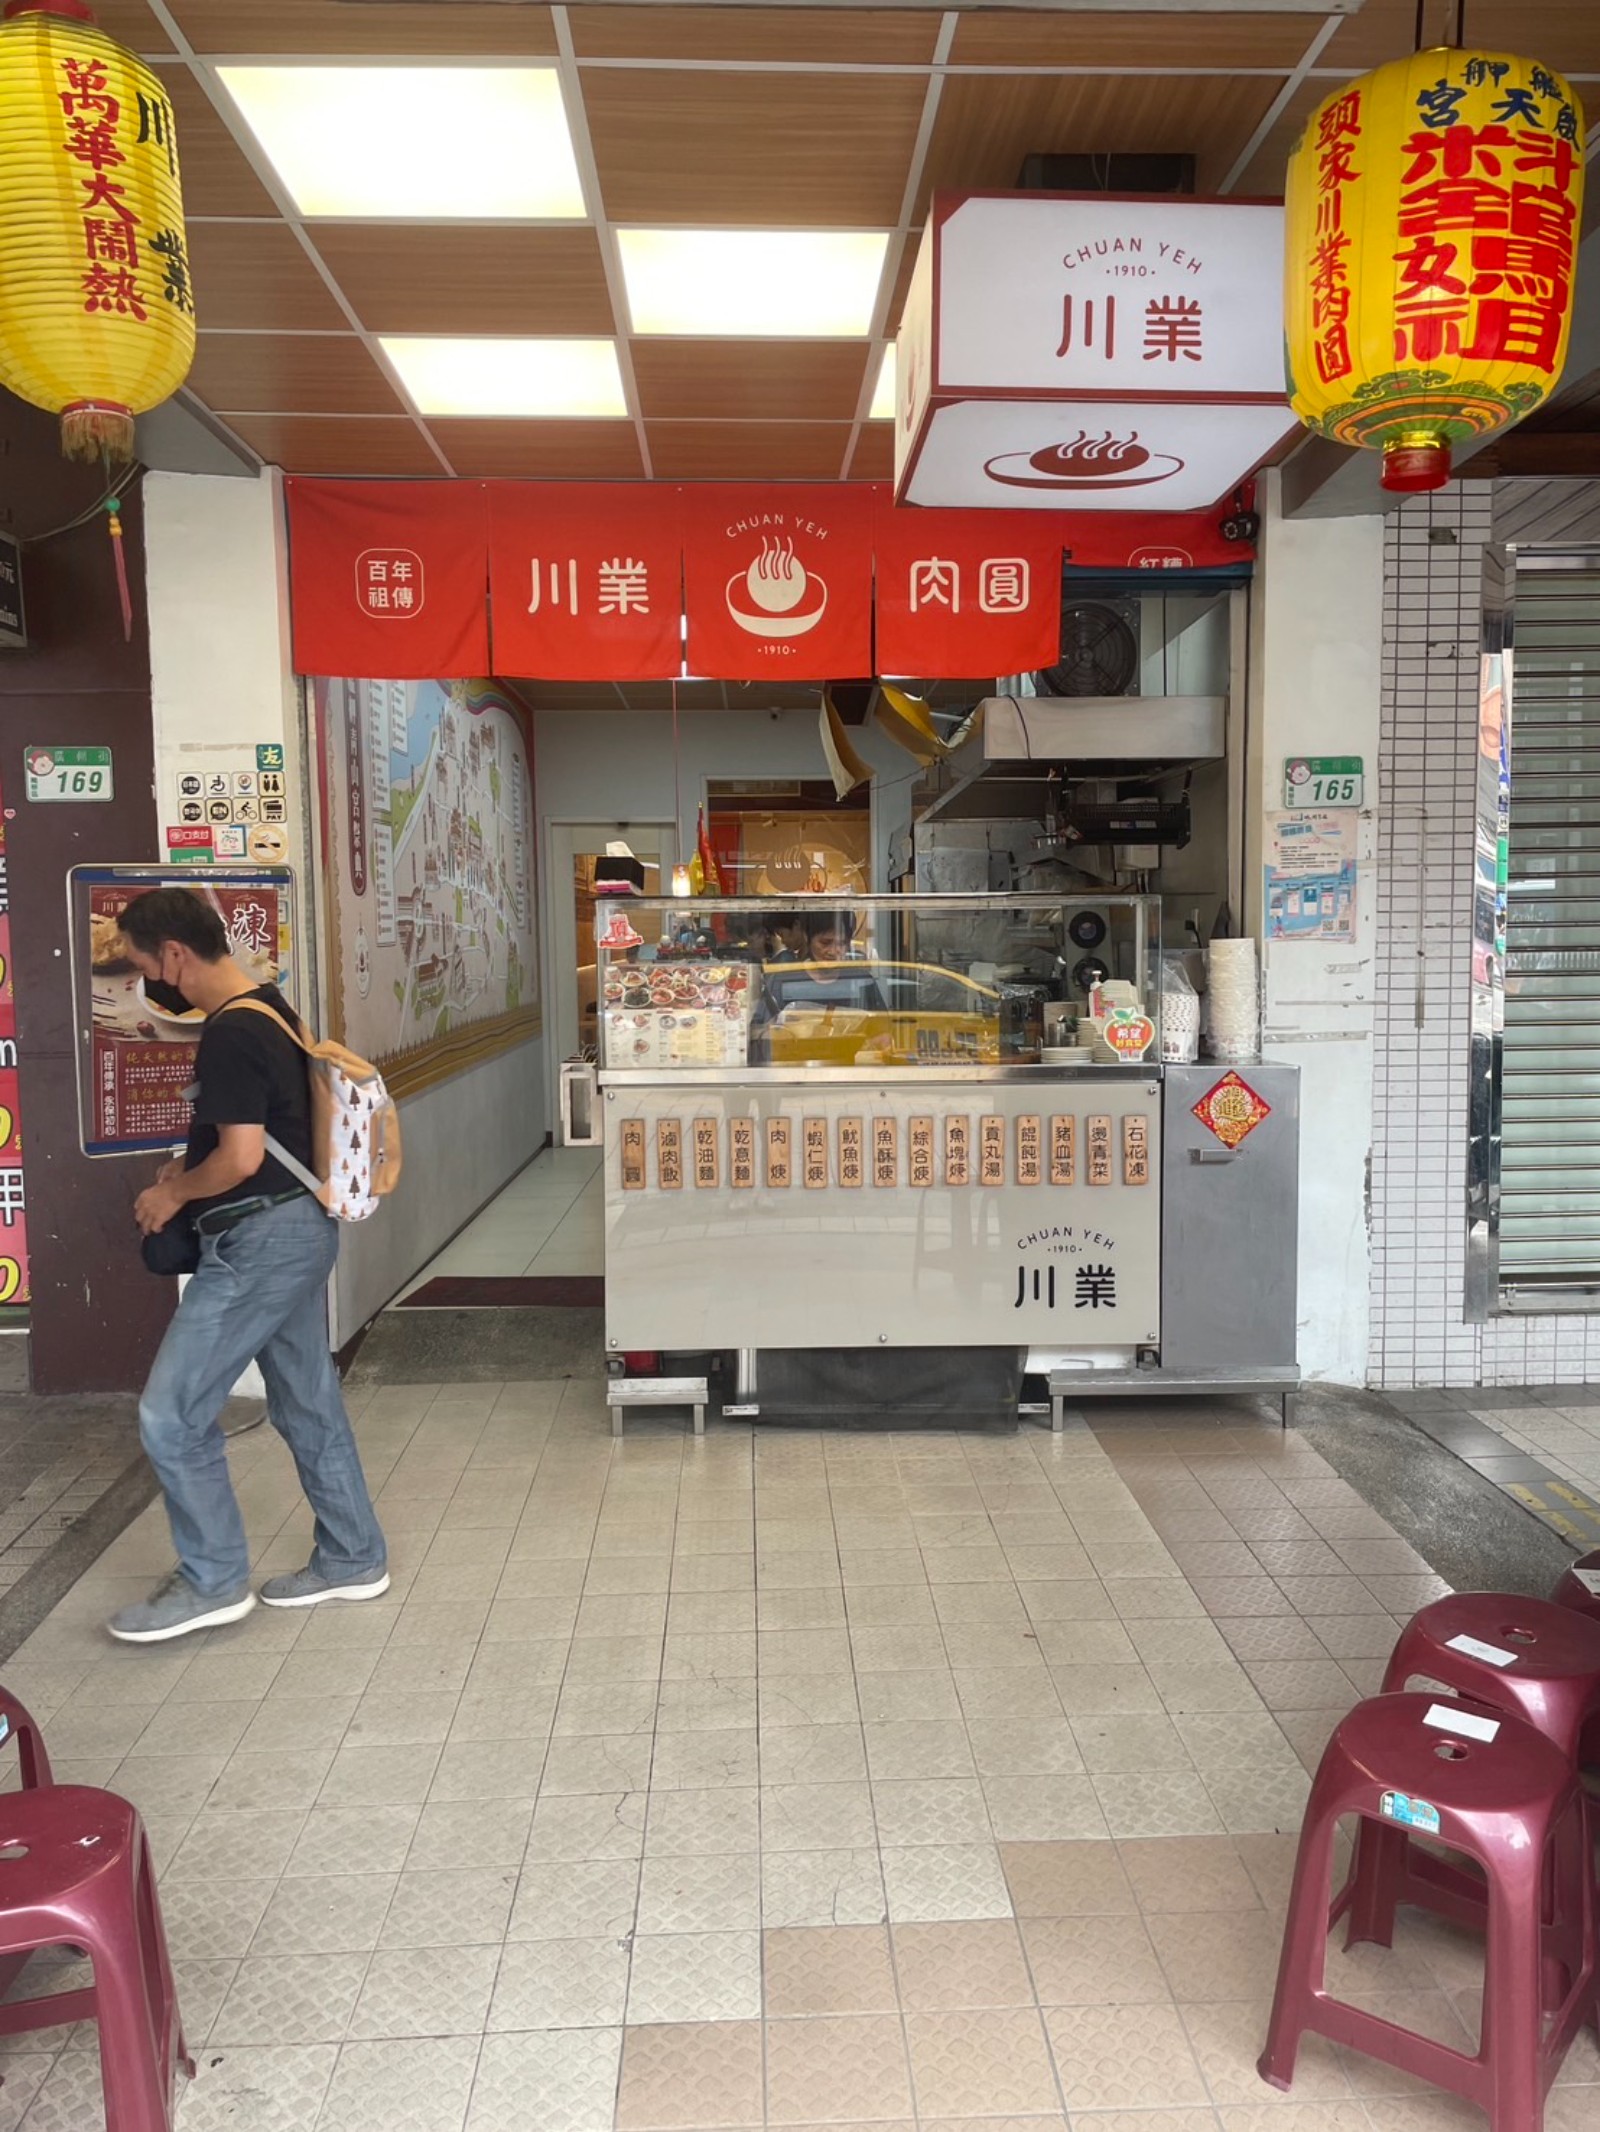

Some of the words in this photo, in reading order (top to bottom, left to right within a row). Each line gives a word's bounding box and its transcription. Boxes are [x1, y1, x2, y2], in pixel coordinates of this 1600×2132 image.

[58, 57, 148, 321] 萬華大鬧熱
[1062, 237, 1143, 270] CHUAN
[1158, 242, 1204, 275] YEH
[1055, 294, 1203, 362] 川業
[725, 513, 785, 539] CHUAN
[794, 516, 829, 541] YEH
[367, 560, 413, 583] 百年
[527, 557, 650, 616] 川業
[909, 556, 1030, 614] 肉圓
[367, 586, 413, 609] 祖傳
[57, 771, 102, 793] 169
[1313, 779, 1354, 801] 165
[624, 1131, 641, 1182] 肉圓
[660, 1131, 679, 1182] 滷肉飯
[984, 1126, 1001, 1179] 貢丸湯
[1020, 1126, 1037, 1179] 餛飩湯
[1054, 1126, 1072, 1178] 豬血湯
[1091, 1126, 1109, 1178] 燙青菜
[1127, 1127, 1146, 1178] 石花凍
[1017, 1226, 1073, 1250] CHUAN
[1083, 1229, 1116, 1251] YEH
[1014, 1264, 1117, 1309] 川業
